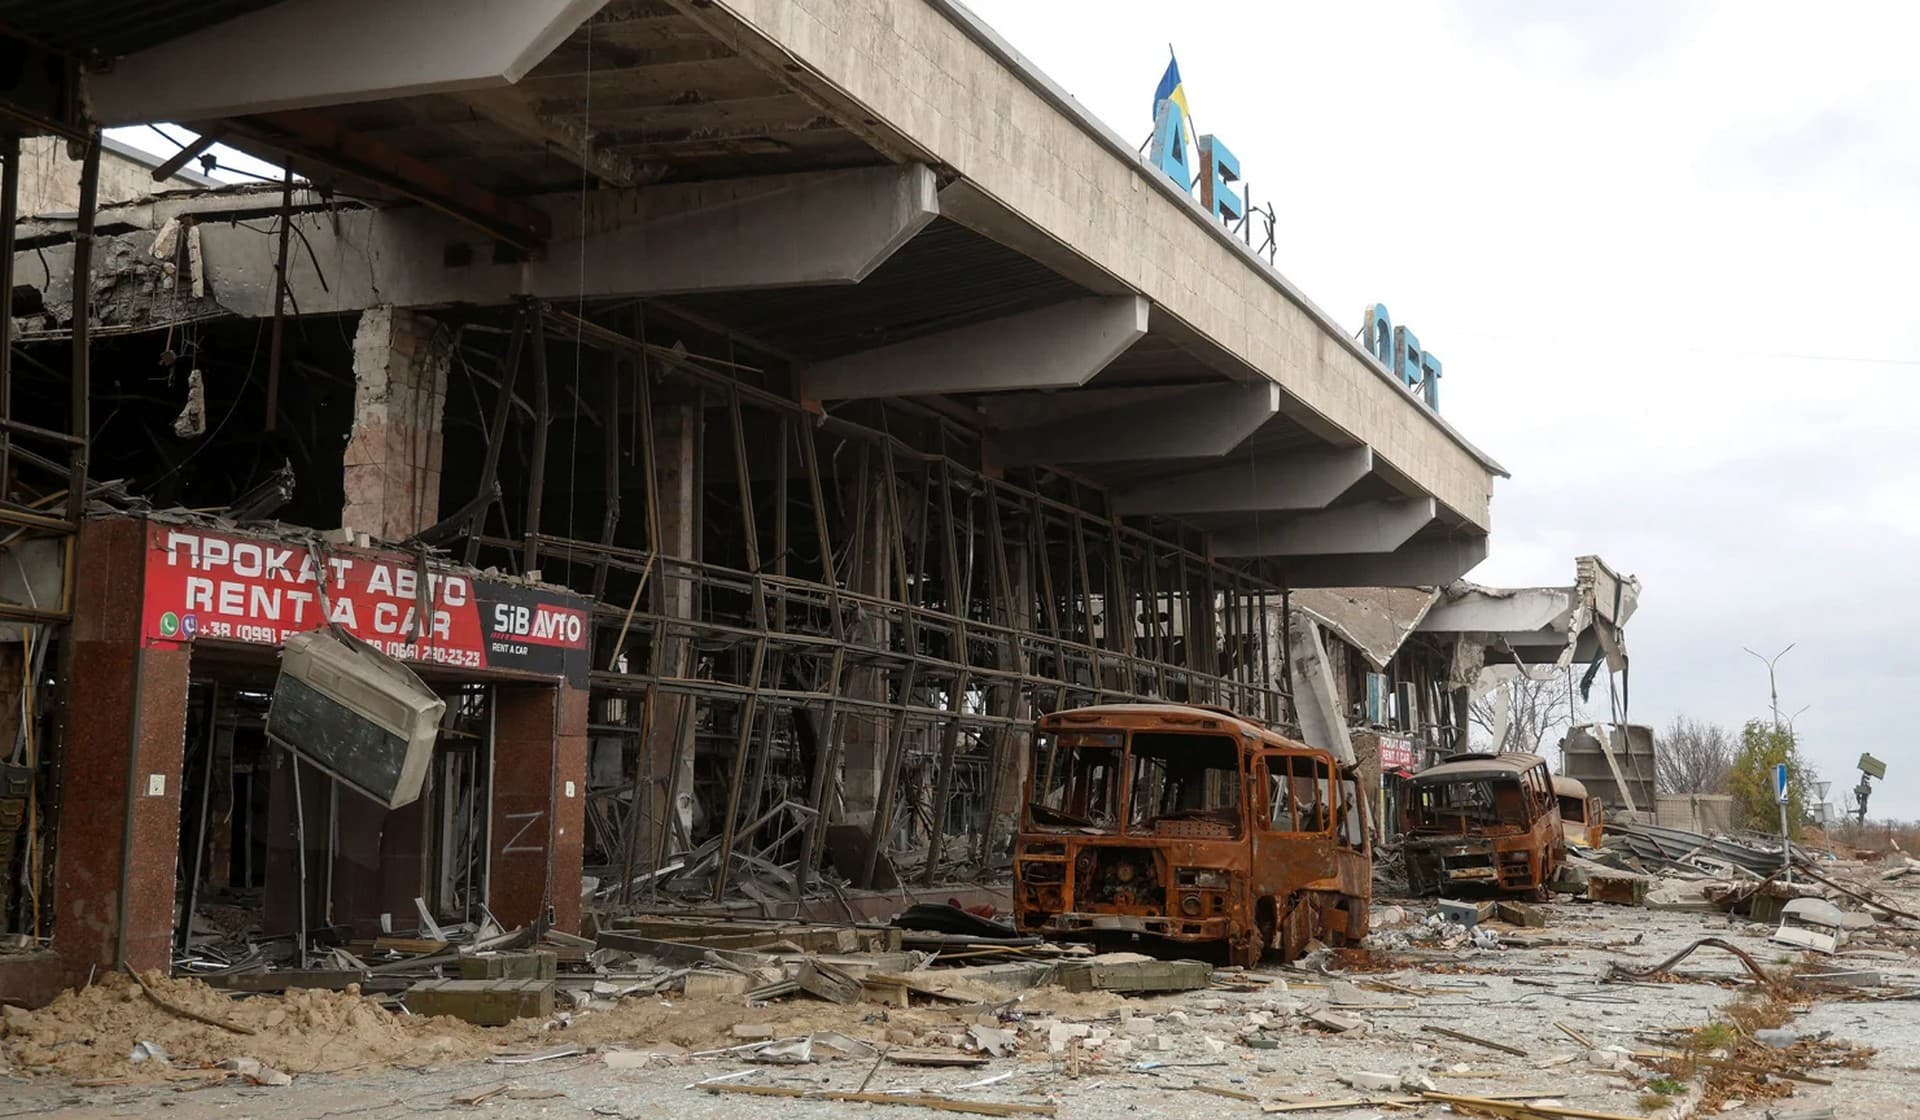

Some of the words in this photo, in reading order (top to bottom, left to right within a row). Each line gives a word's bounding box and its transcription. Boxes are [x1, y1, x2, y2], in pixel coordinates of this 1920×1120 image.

[168, 532, 353, 590] ПРОКАТ
[366, 565, 466, 607] АВТО
[186, 576, 313, 622] RENT
[329, 597, 358, 630] A
[374, 602, 451, 640] CAR
[492, 642, 509, 653] RENT
[515, 646, 529, 656] CAR
